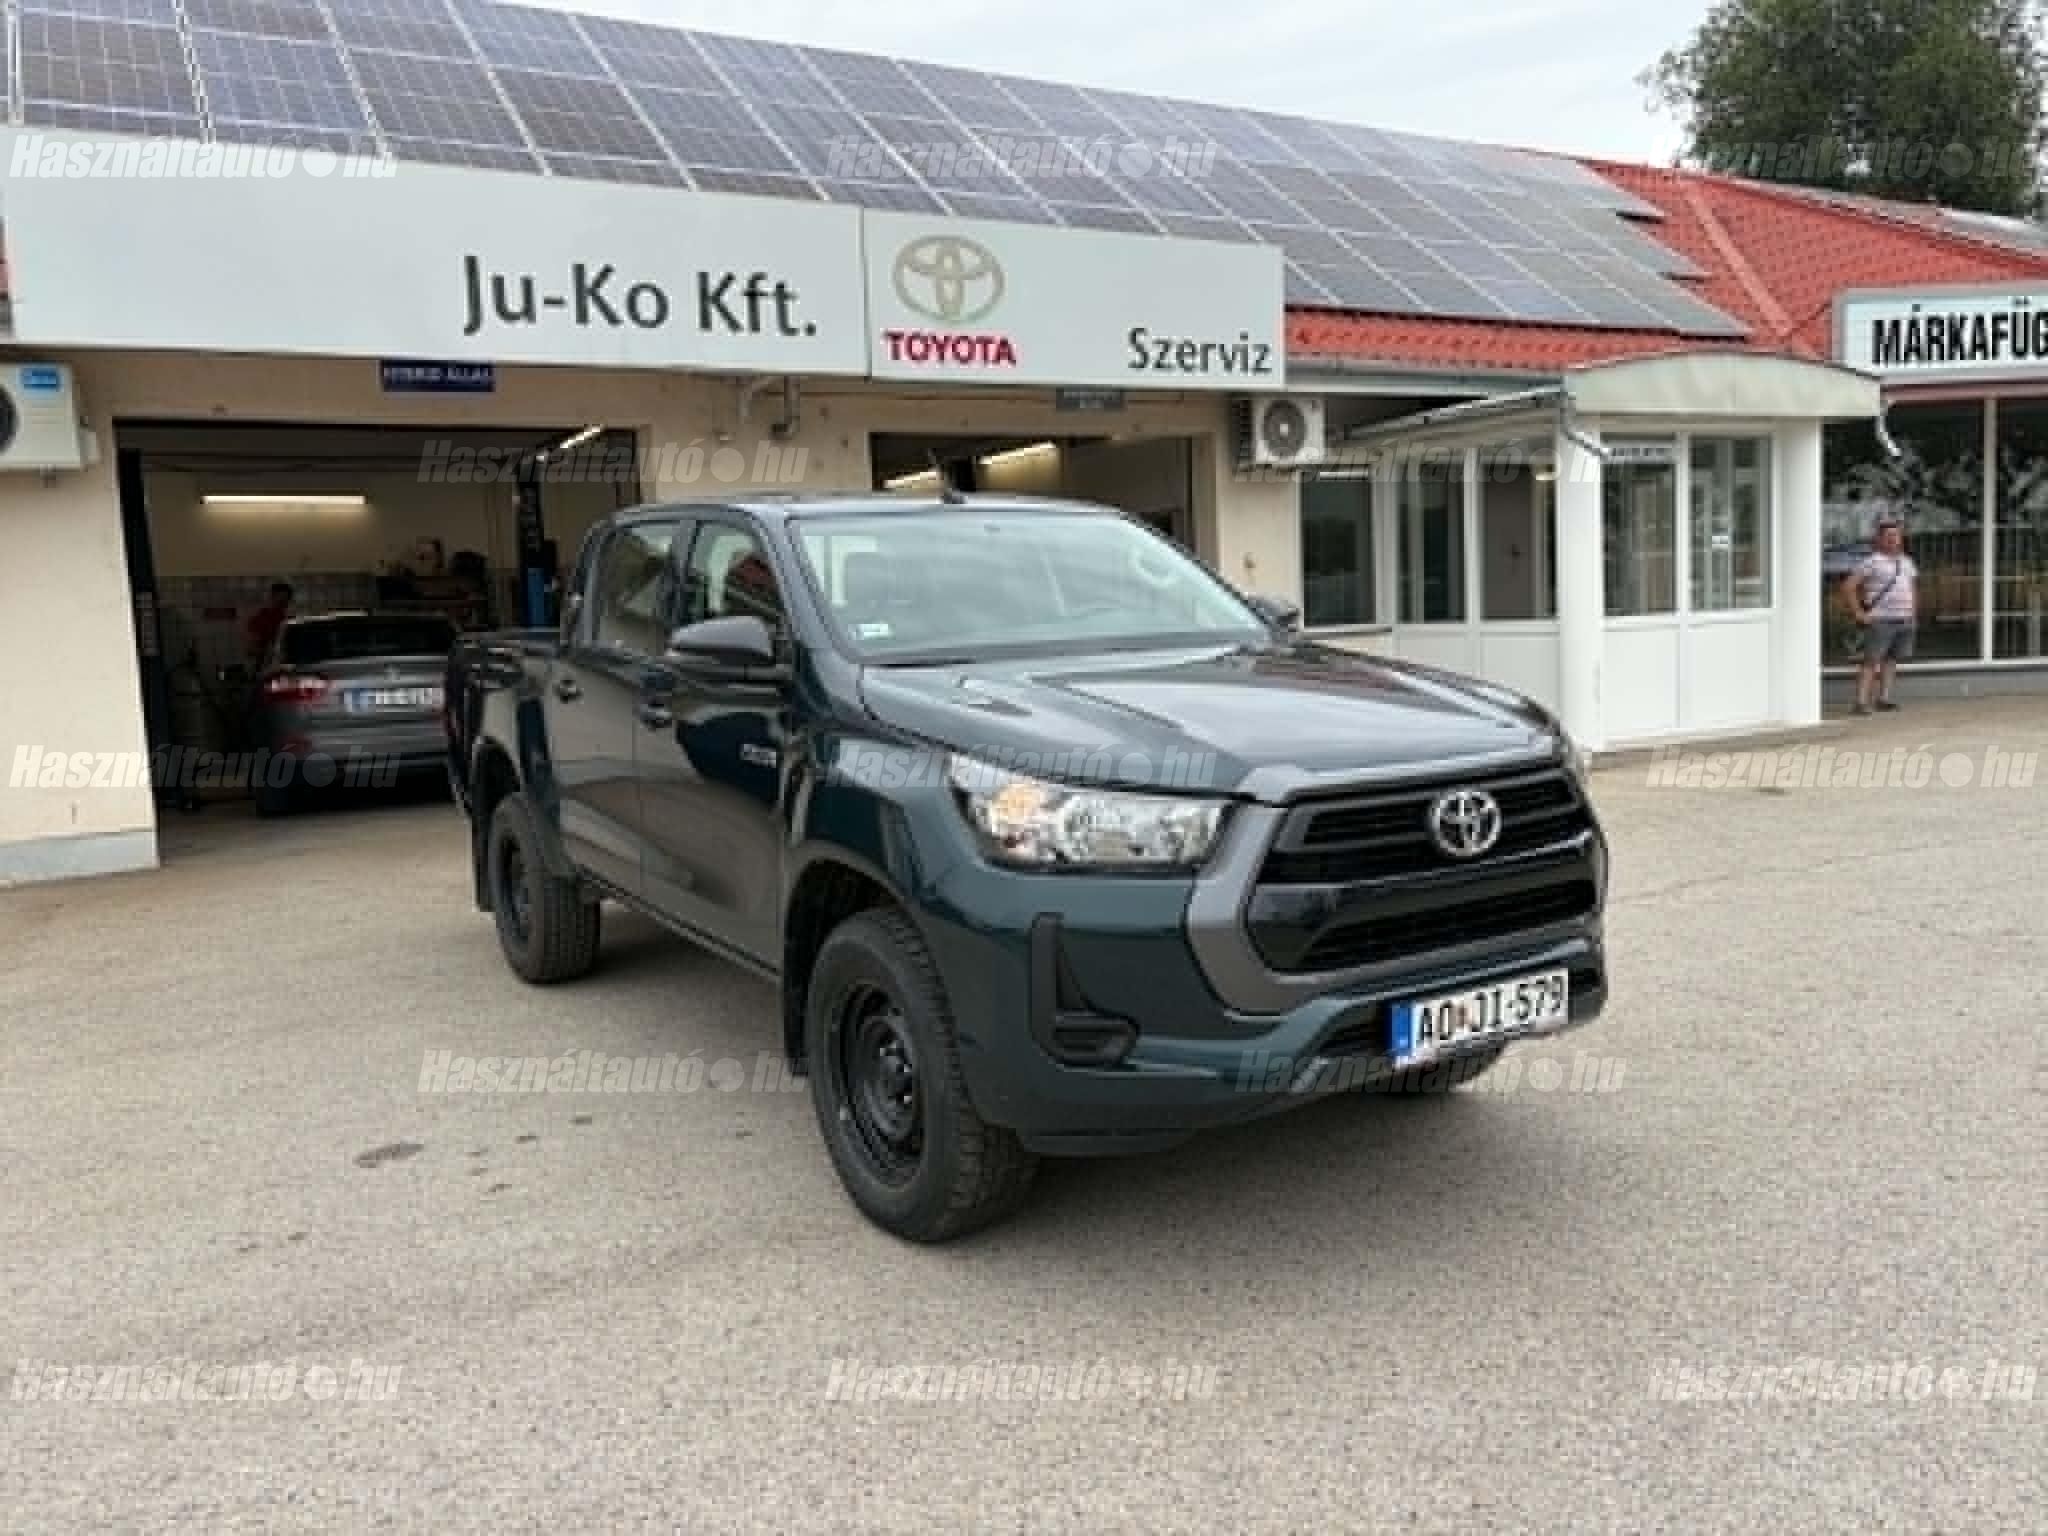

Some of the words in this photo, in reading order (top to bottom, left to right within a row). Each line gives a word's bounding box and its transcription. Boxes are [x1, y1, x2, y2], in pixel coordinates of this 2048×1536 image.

[464, 255, 668, 335] Ju-Ko
[699, 270, 816, 336] Kft.
[884, 331, 1016, 367] TOYOTA
[1129, 328, 1272, 374] Szerviz
